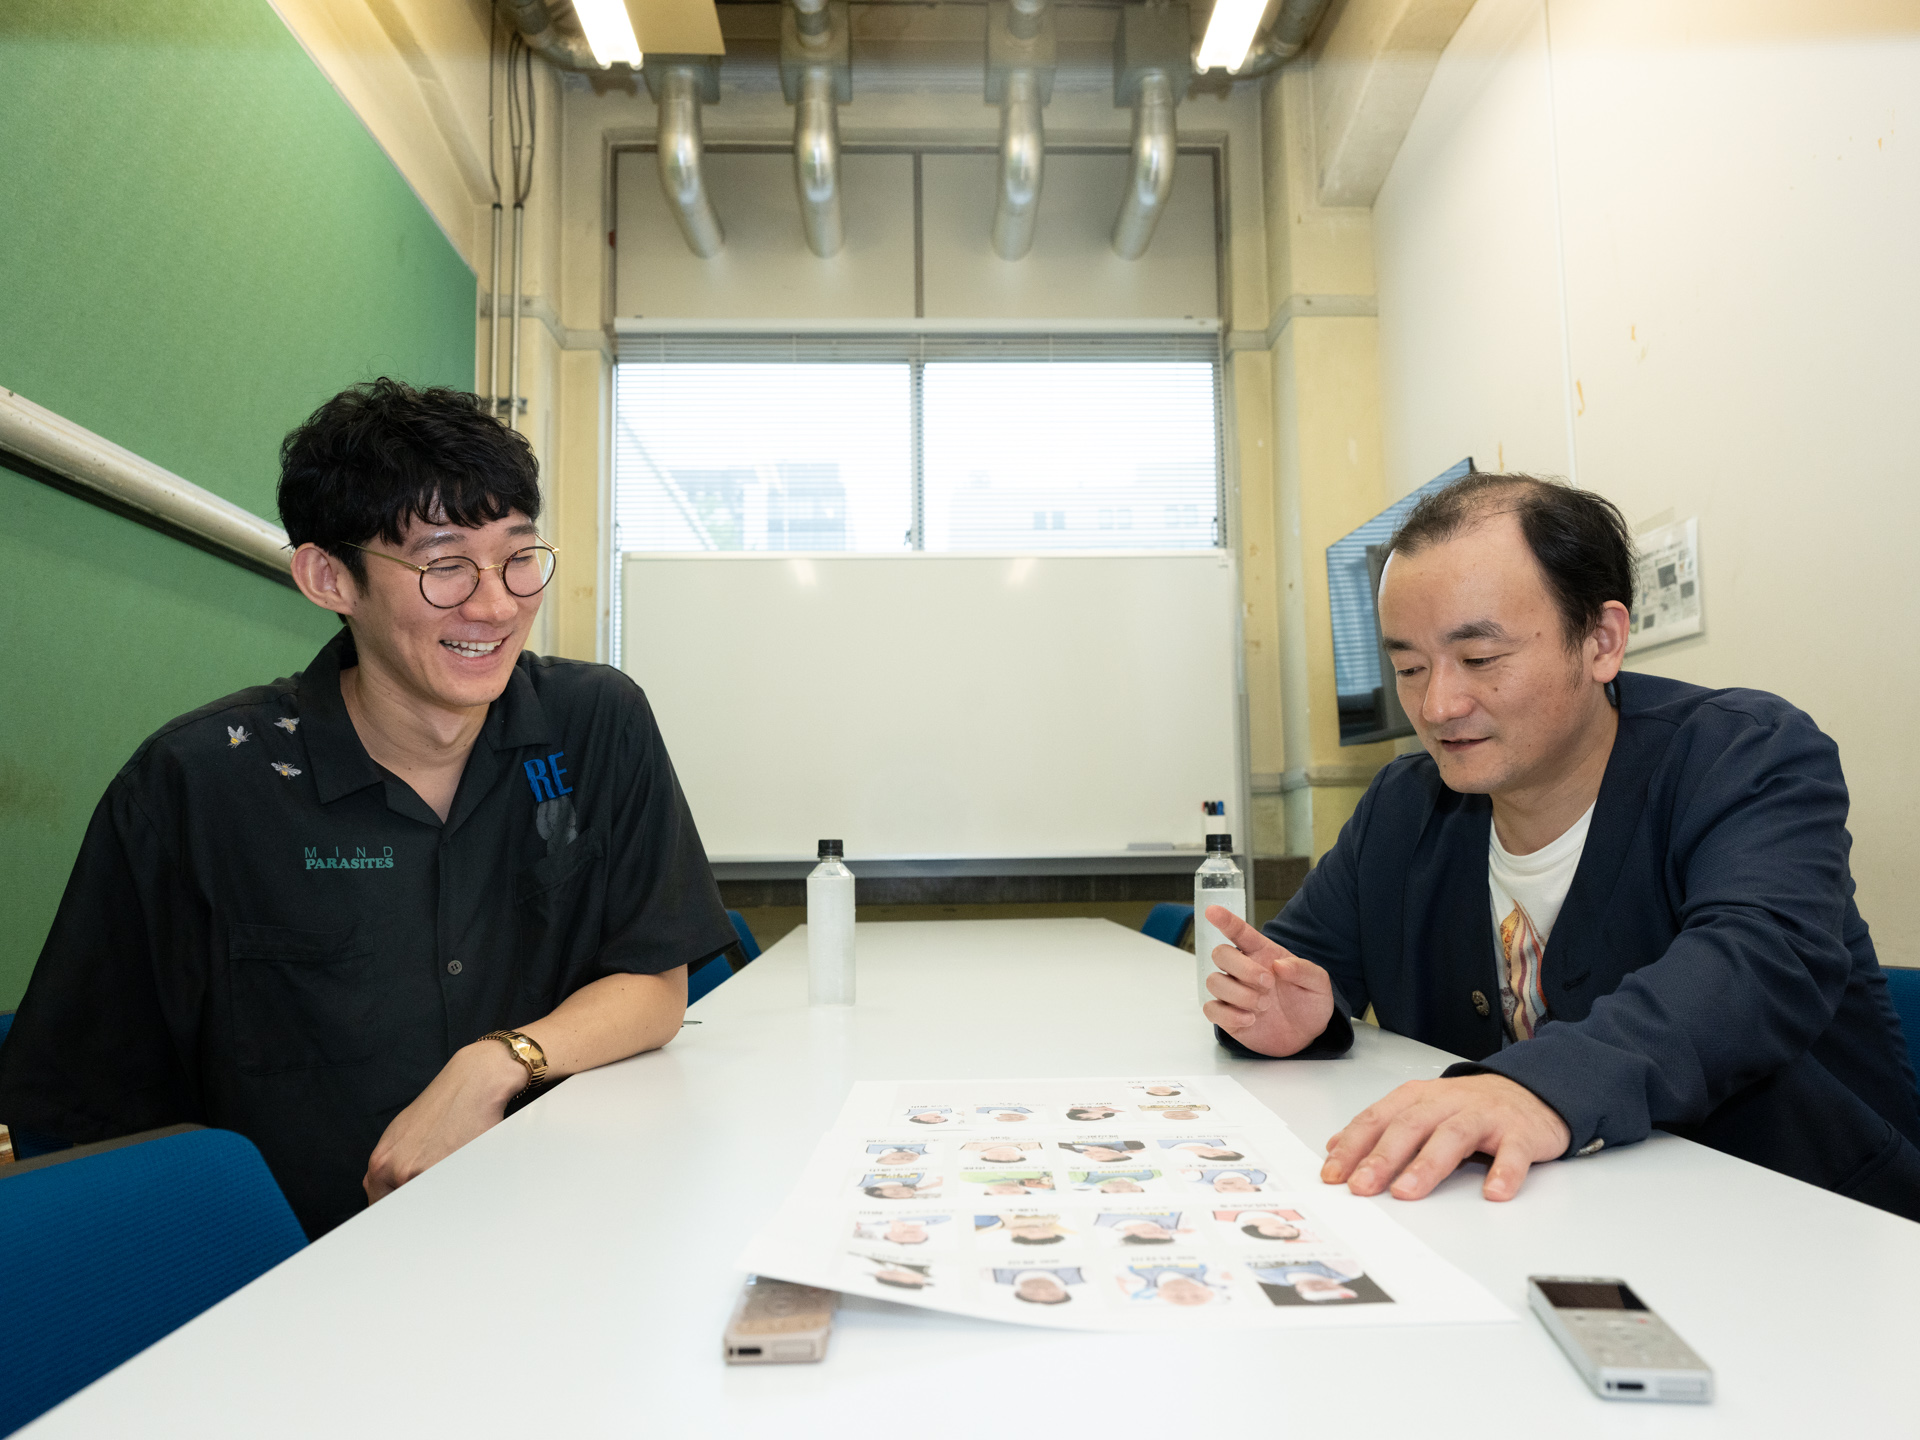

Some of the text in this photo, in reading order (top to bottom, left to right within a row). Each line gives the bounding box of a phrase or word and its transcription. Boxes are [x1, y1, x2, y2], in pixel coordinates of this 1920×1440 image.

[524, 751, 573, 802] RE
[305, 846, 393, 858] MIND
[305, 858, 394, 869] PARASITES
